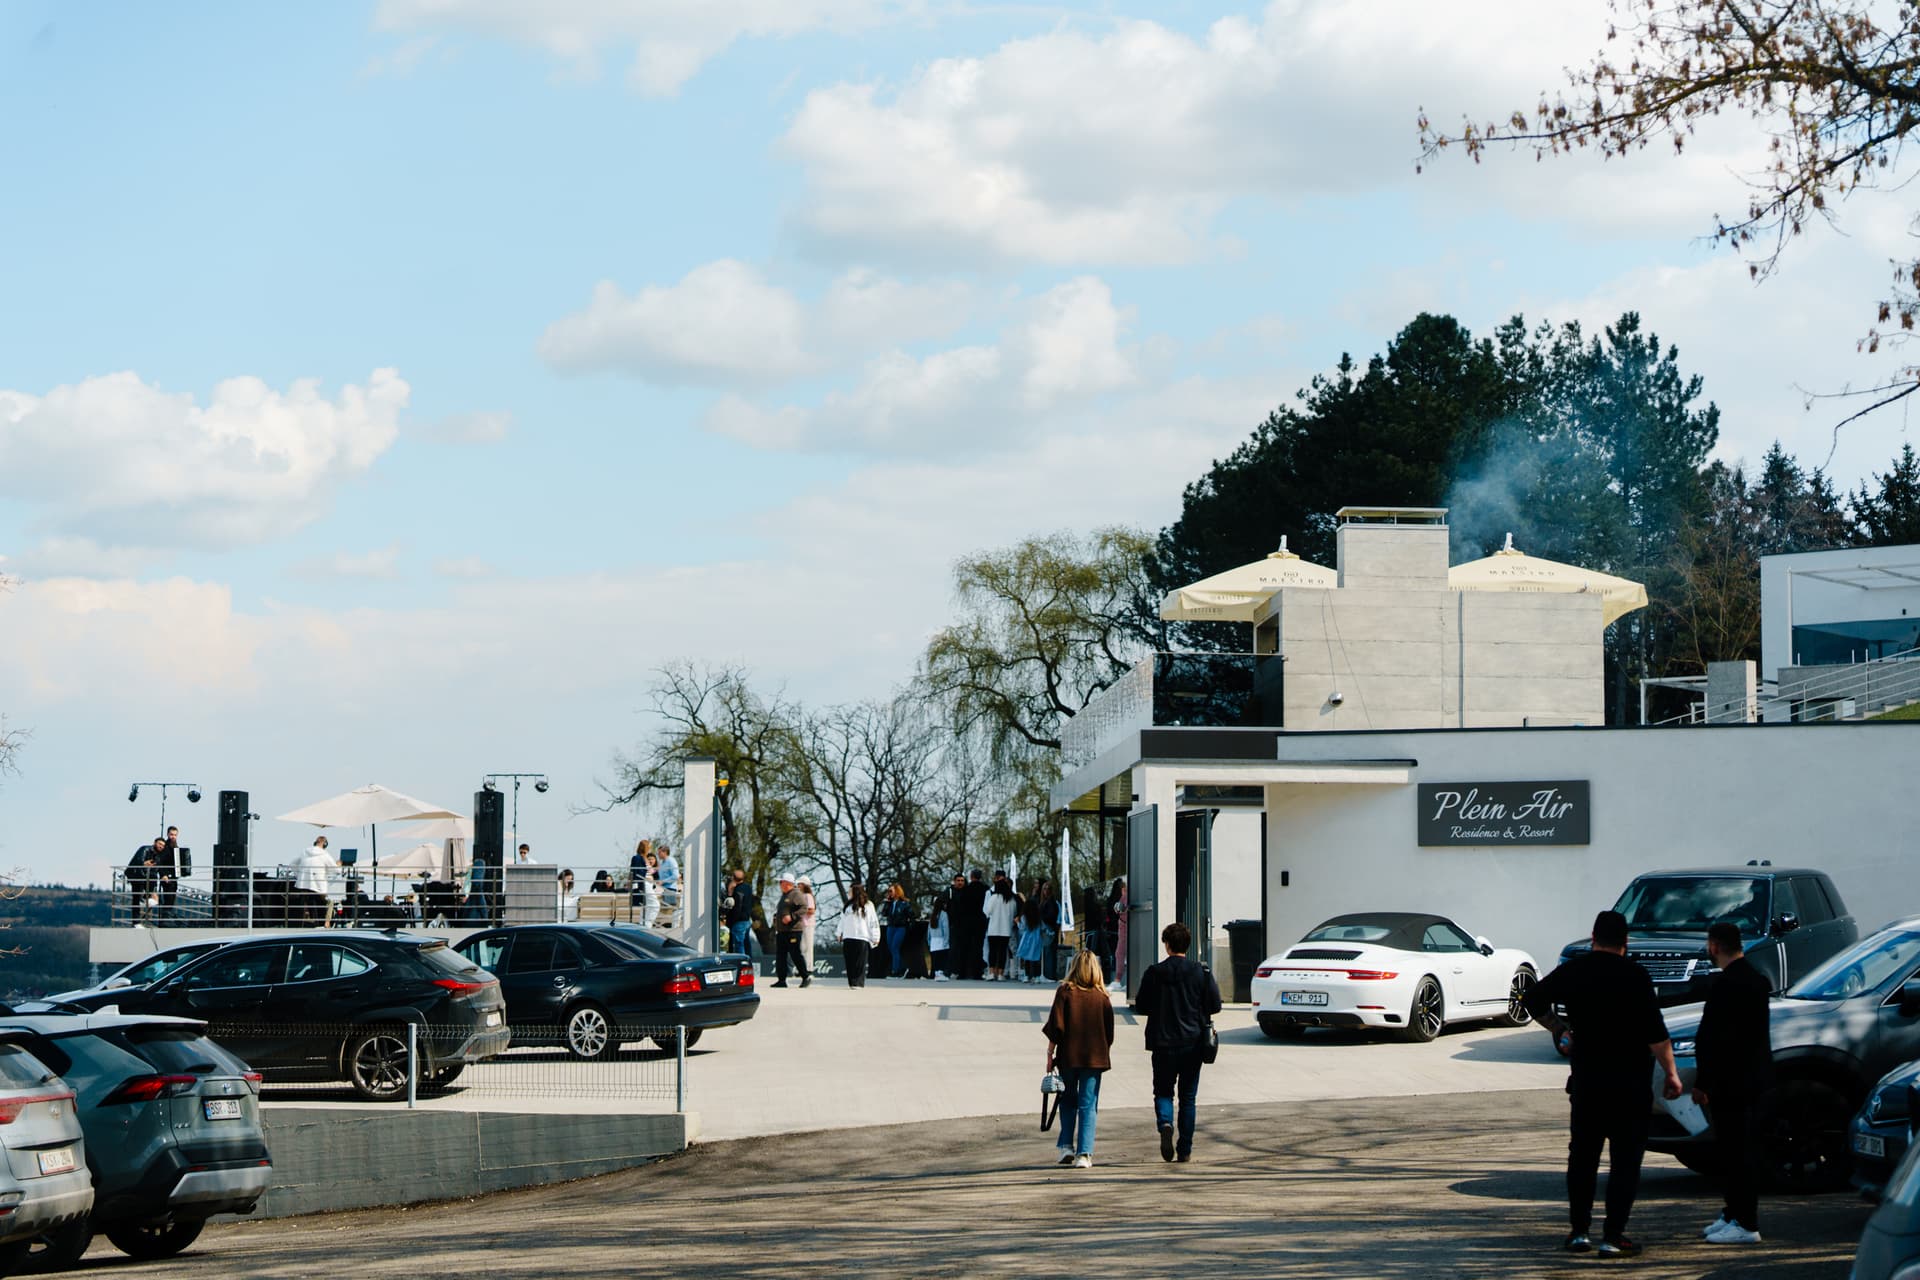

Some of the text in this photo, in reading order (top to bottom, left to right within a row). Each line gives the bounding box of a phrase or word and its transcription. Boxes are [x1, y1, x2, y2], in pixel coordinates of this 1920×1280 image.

[1432, 788, 1573, 821] Plein Air
[1450, 824, 1555, 839] Residence & Resort
[1289, 994, 1322, 1003] KEM 911
